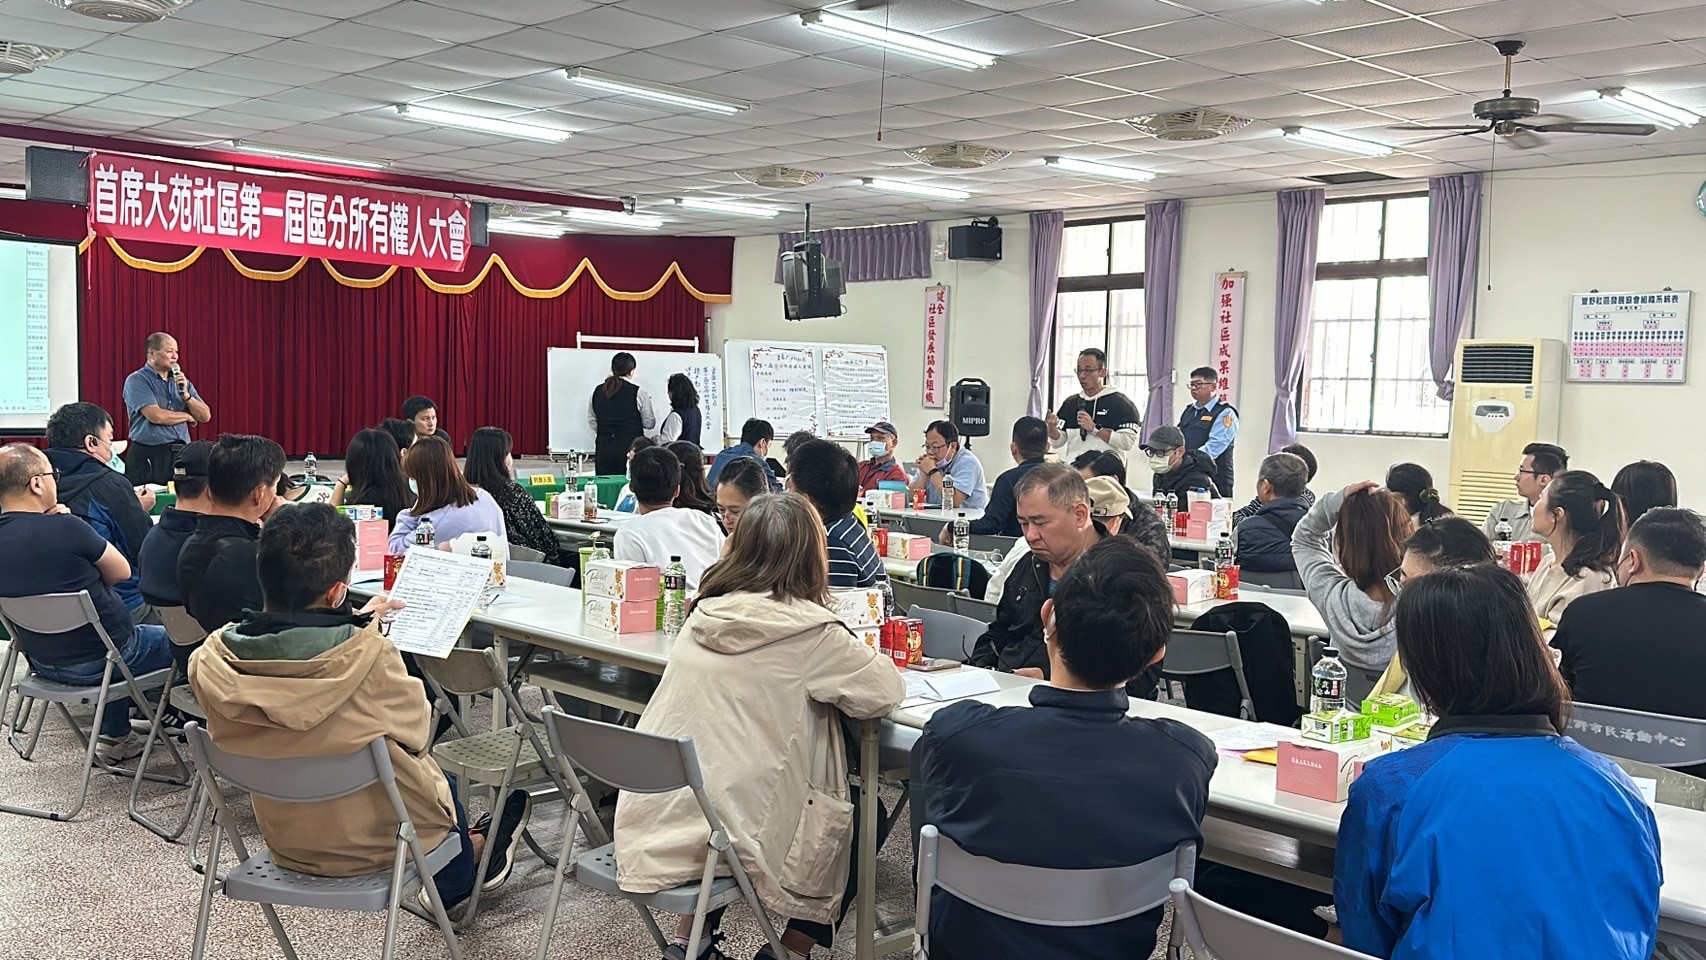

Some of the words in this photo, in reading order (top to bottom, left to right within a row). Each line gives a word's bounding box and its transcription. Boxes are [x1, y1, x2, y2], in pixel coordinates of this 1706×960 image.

[94, 162, 467, 261] 首席大苑社區第一屆區分所有權人大會
[936, 291, 945, 315] 健全
[962, 416, 986, 426] MIPRO
